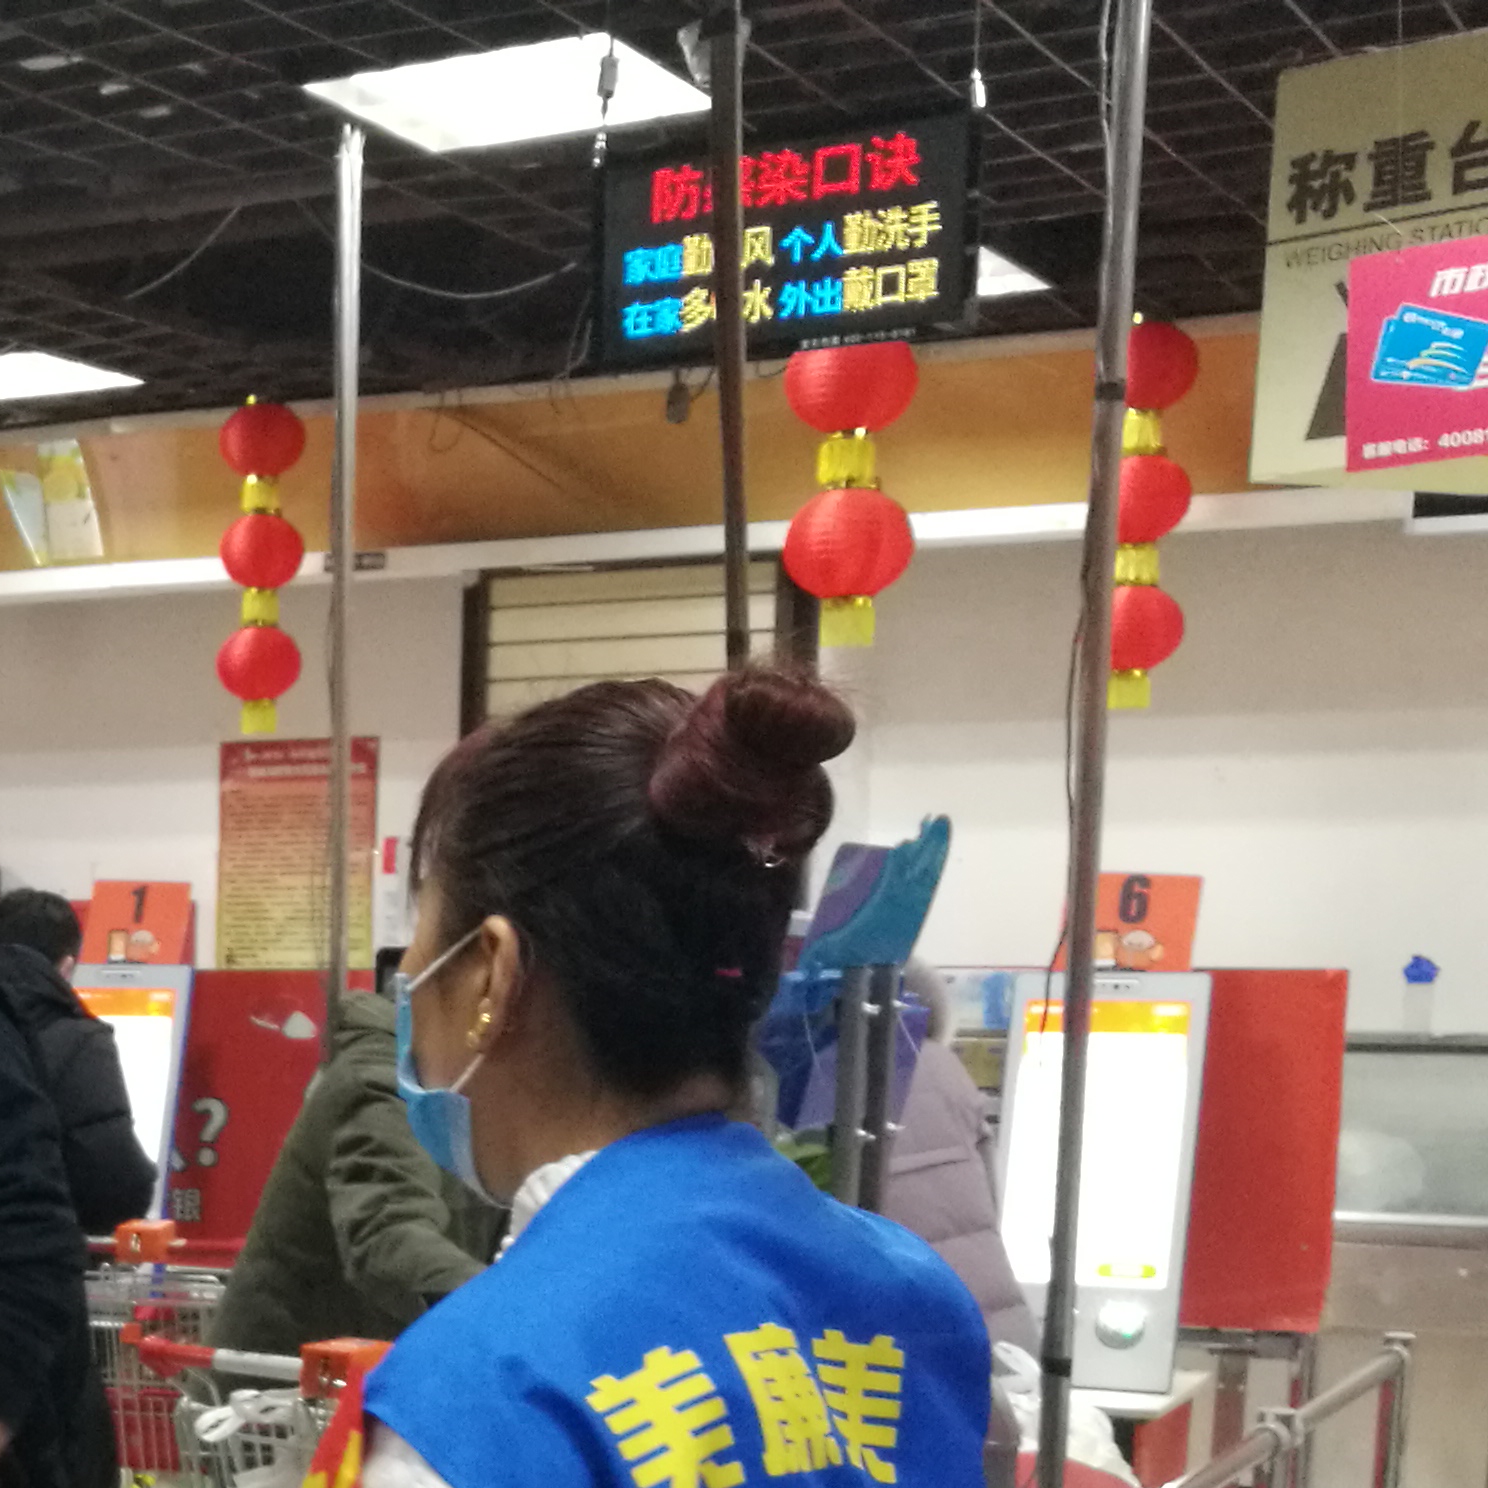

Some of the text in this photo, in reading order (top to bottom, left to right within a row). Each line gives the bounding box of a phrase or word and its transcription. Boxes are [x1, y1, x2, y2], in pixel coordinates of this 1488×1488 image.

[1287, 120, 1488, 225] 称重台
[622, 200, 943, 290] 家庭勤风 个人勤洗手
[1285, 232, 1404, 268] WEIGHING
[620, 256, 940, 341] 在家多水 外出戴口罩
[131, 885, 148, 924] 1
[1118, 874, 1151, 924] 6
